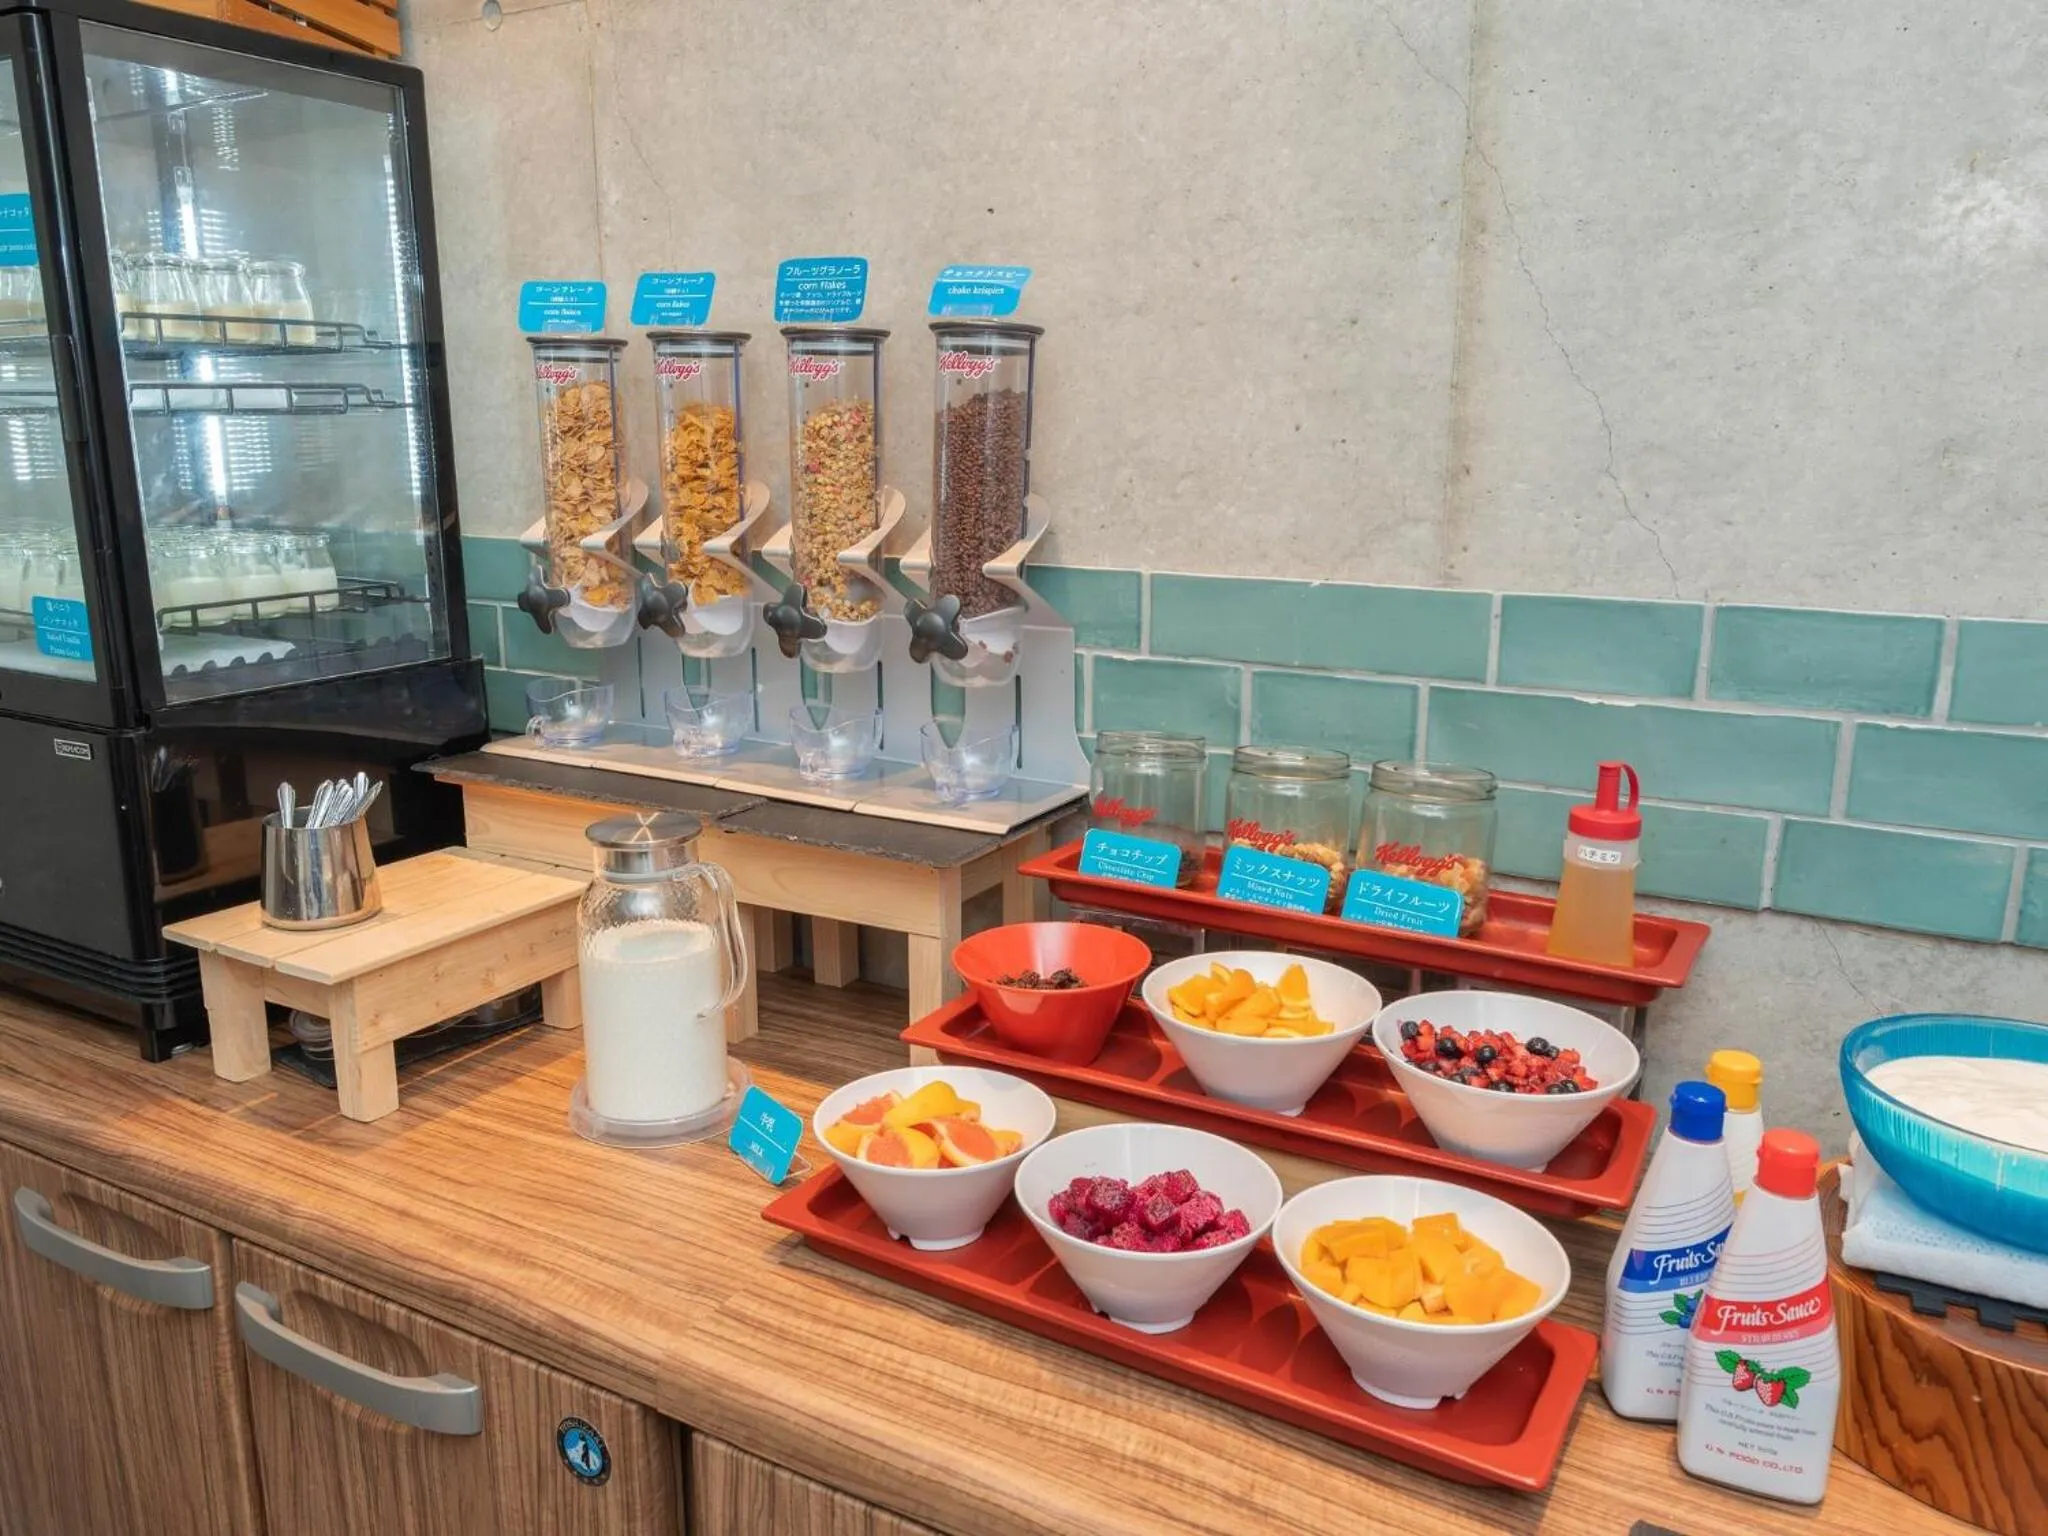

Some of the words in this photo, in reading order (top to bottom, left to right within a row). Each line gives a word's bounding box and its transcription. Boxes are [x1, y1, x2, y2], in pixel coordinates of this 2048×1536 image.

[785, 264, 861, 276] フルーツグラノーラ
[798, 282, 817, 291] corn
[939, 351, 996, 377] Kellogg's
[1227, 817, 1296, 850] Kellogg's
[1095, 842, 1169, 866] チョコチップ
[1375, 841, 1464, 877] Kellogg's
[1233, 857, 1320, 889] ミックスナッツ
[1247, 881, 1272, 894] Mixed
[1273, 888, 1293, 900] Nuts
[1358, 881, 1450, 913] ドライフルーツ
[1374, 906, 1399, 920] Dried
[1400, 914, 1424, 926] Fruit
[1648, 1248, 1701, 1285] Fruits
[1710, 1304, 1771, 1336] Fruits
[1769, 1297, 1821, 1326] Sauce
